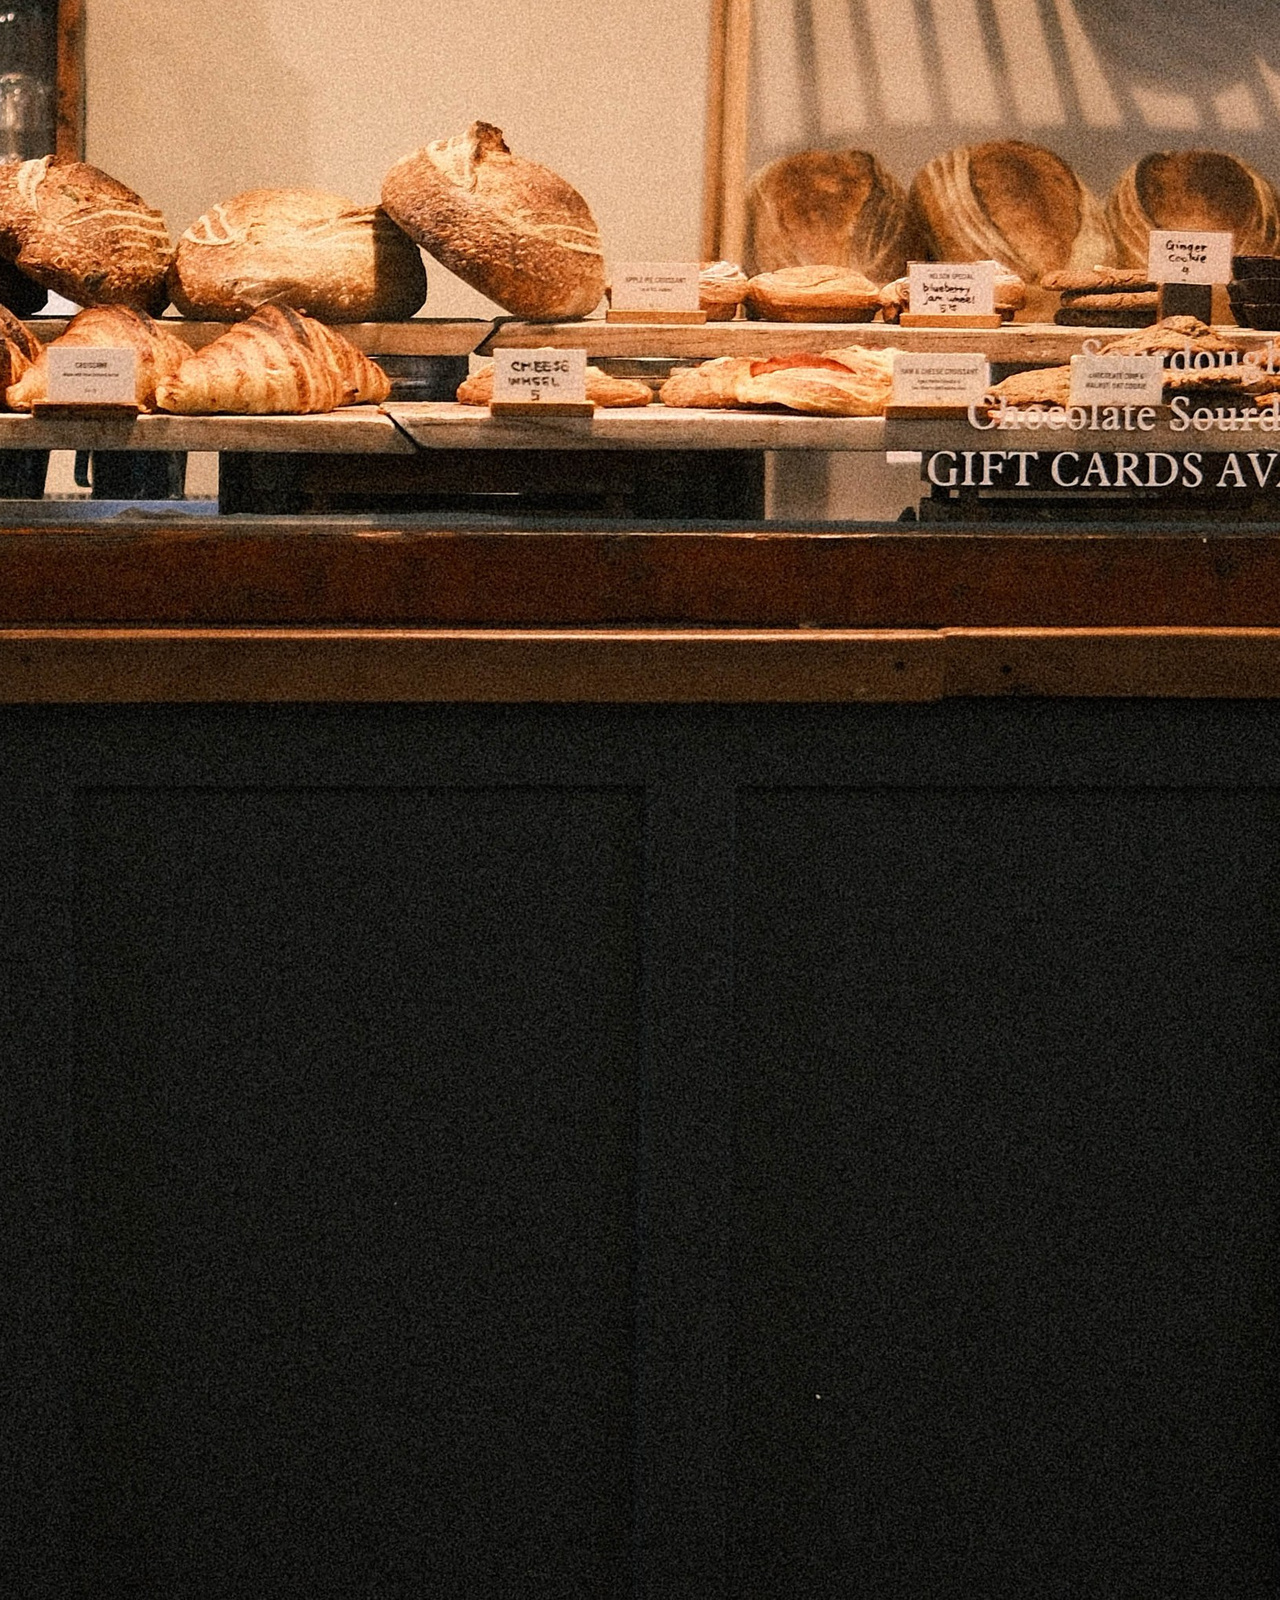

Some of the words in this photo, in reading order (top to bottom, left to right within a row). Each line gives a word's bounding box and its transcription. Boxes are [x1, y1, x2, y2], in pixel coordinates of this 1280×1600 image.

[1165, 239, 1208, 252] Ginger
[1168, 252, 1207, 263] cookie
[922, 282, 971, 296] blueberry
[510, 360, 569, 373] CHEESE
[1082, 339, 1280, 384] Srdoug
[508, 376, 560, 387] WHEEL
[530, 389, 541, 401] 5
[967, 394, 1157, 431] Chocolate
[1169, 395, 1280, 432] Sourd
[927, 450, 1039, 487] GIFT
[1051, 451, 1203, 488] CARDS
[1216, 452, 1280, 488] AV
